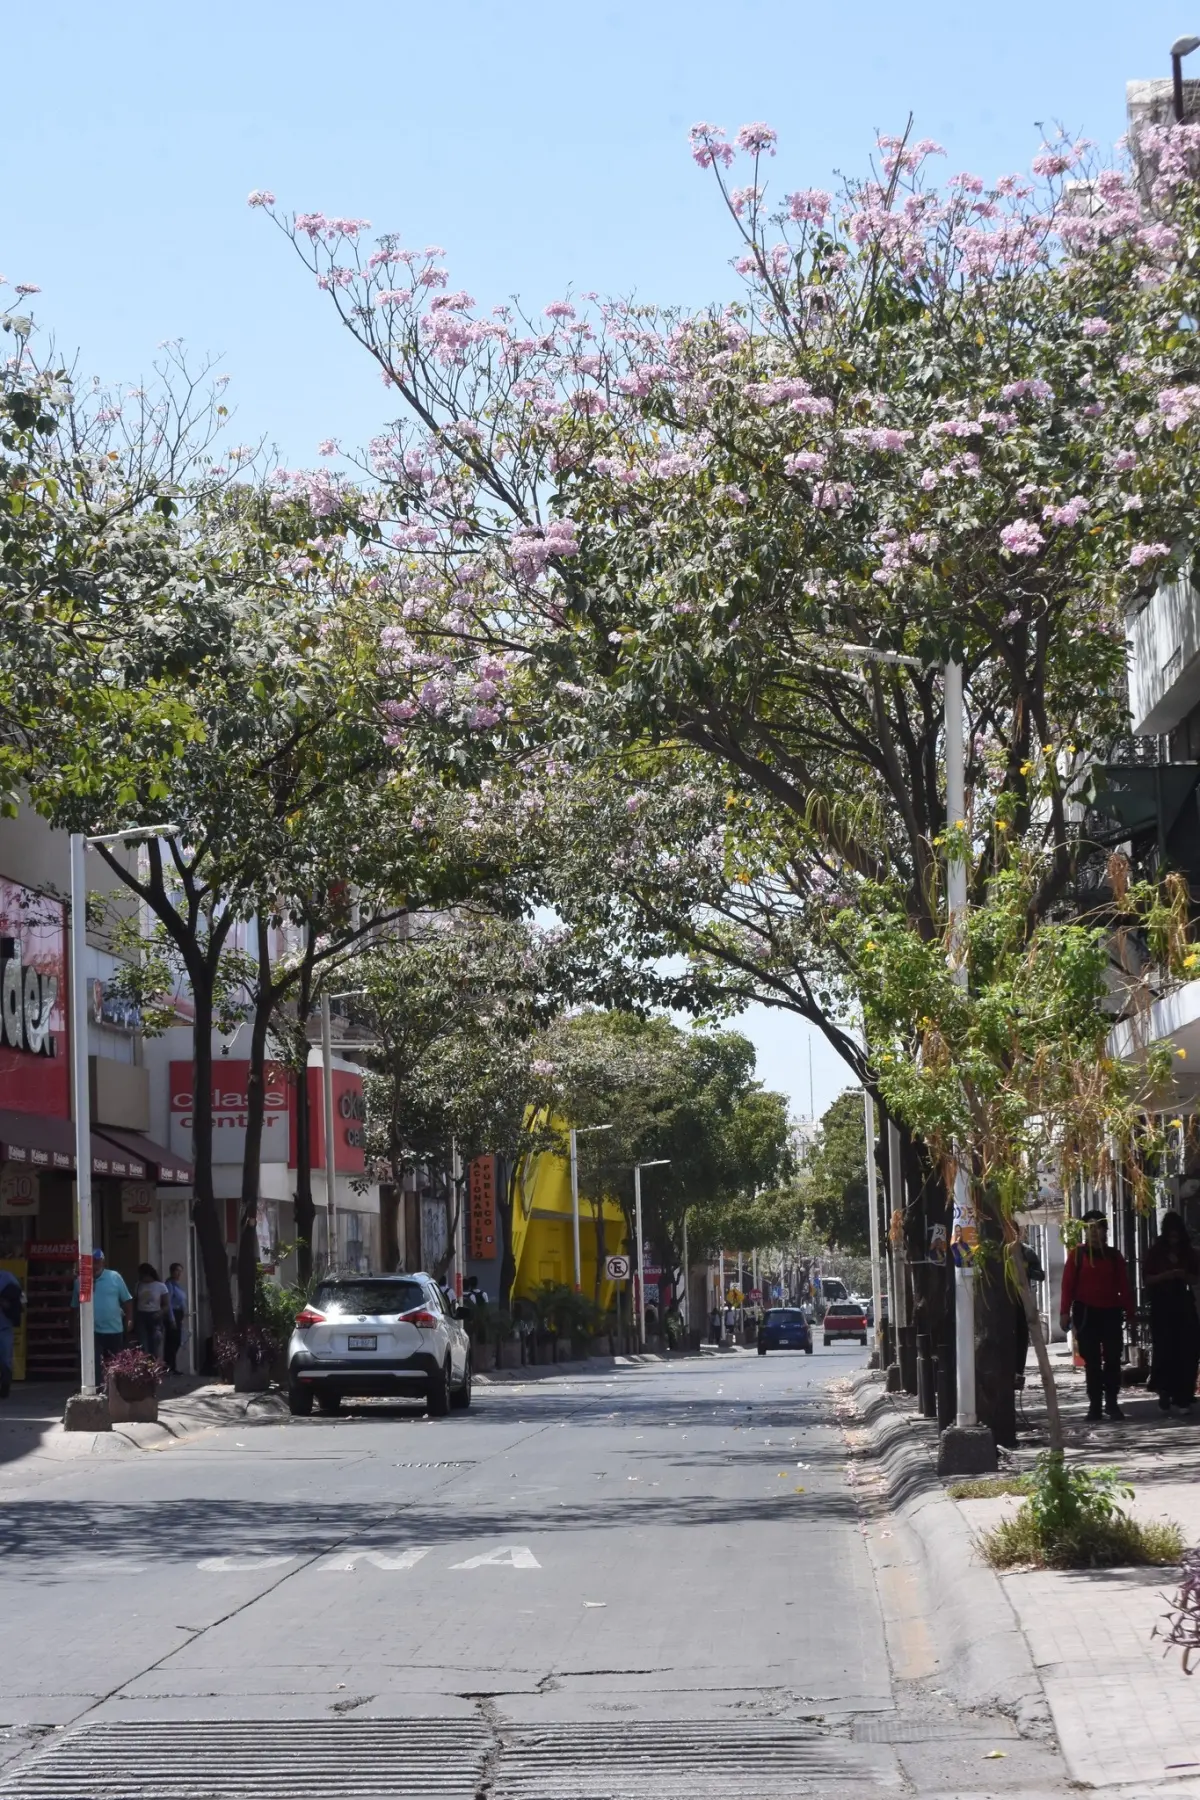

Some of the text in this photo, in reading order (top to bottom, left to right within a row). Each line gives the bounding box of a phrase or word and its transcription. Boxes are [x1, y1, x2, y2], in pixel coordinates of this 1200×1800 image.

[0, 938, 57, 1058] der.
[172, 1088, 285, 1107] clas
[179, 1113, 280, 1129] cntr
